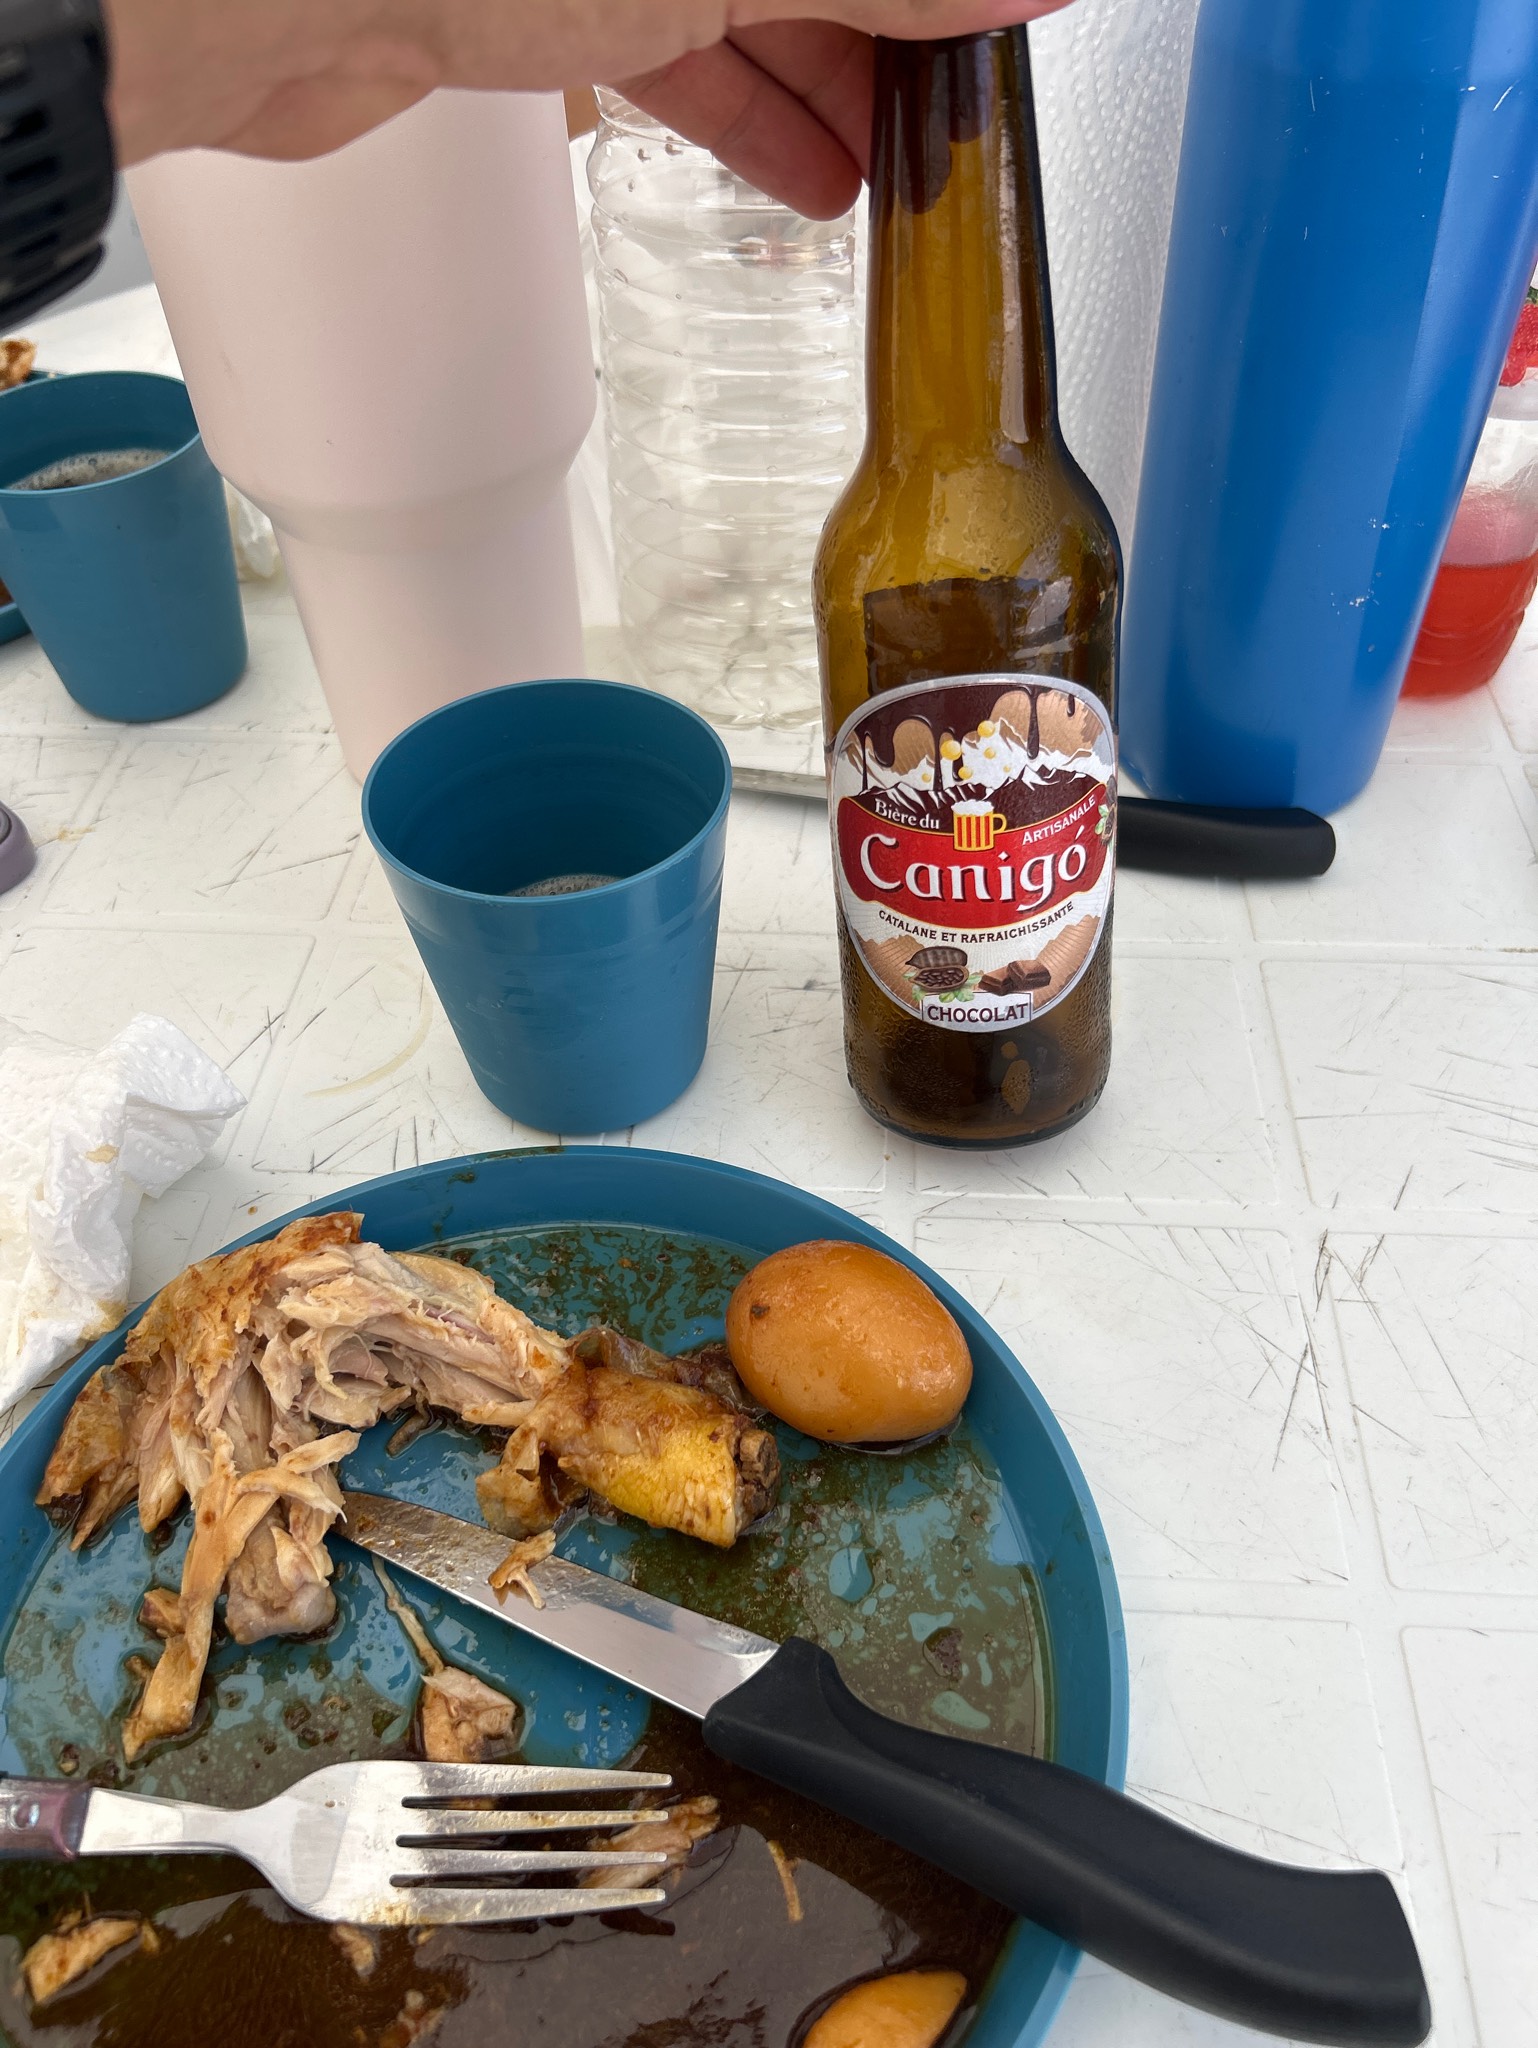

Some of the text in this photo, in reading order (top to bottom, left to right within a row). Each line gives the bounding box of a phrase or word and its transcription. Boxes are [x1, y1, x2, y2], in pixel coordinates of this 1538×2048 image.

[874, 797, 940, 830] Bière du
[1021, 794, 1097, 846] ARTISANALE
[859, 825, 1088, 912] Canigó
[878, 901, 1074, 944] CATALANE ET RAFRAICHISSANTE
[927, 1002, 1029, 1023] CHOCOLAT
